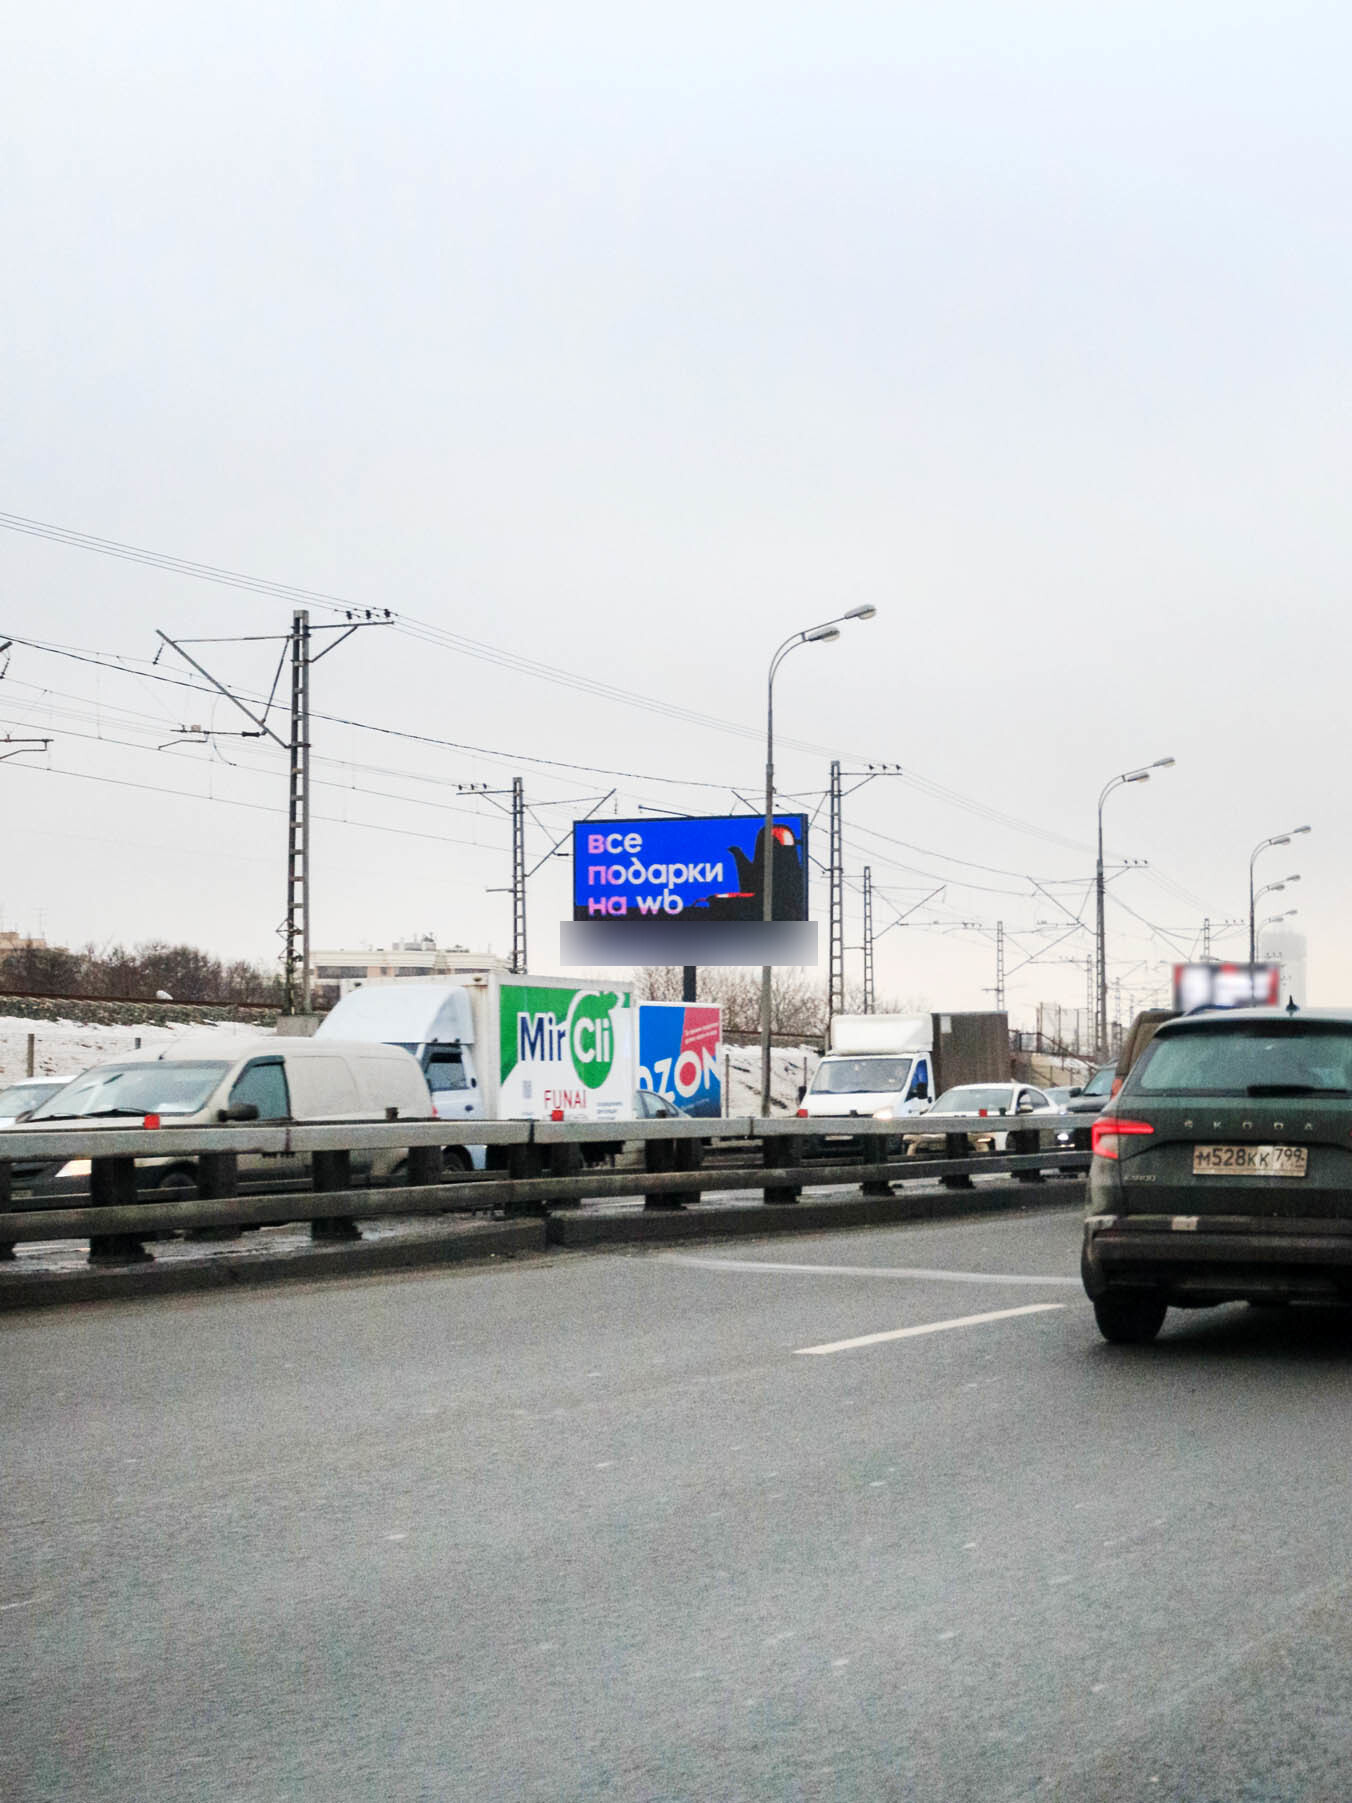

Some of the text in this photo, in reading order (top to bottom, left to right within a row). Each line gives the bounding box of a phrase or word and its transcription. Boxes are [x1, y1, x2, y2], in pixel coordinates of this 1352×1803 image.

[588, 833, 642, 854] все
[588, 857, 723, 889] подарки
[588, 889, 683, 915] на wb
[544, 1089, 586, 1109] FUNAI
